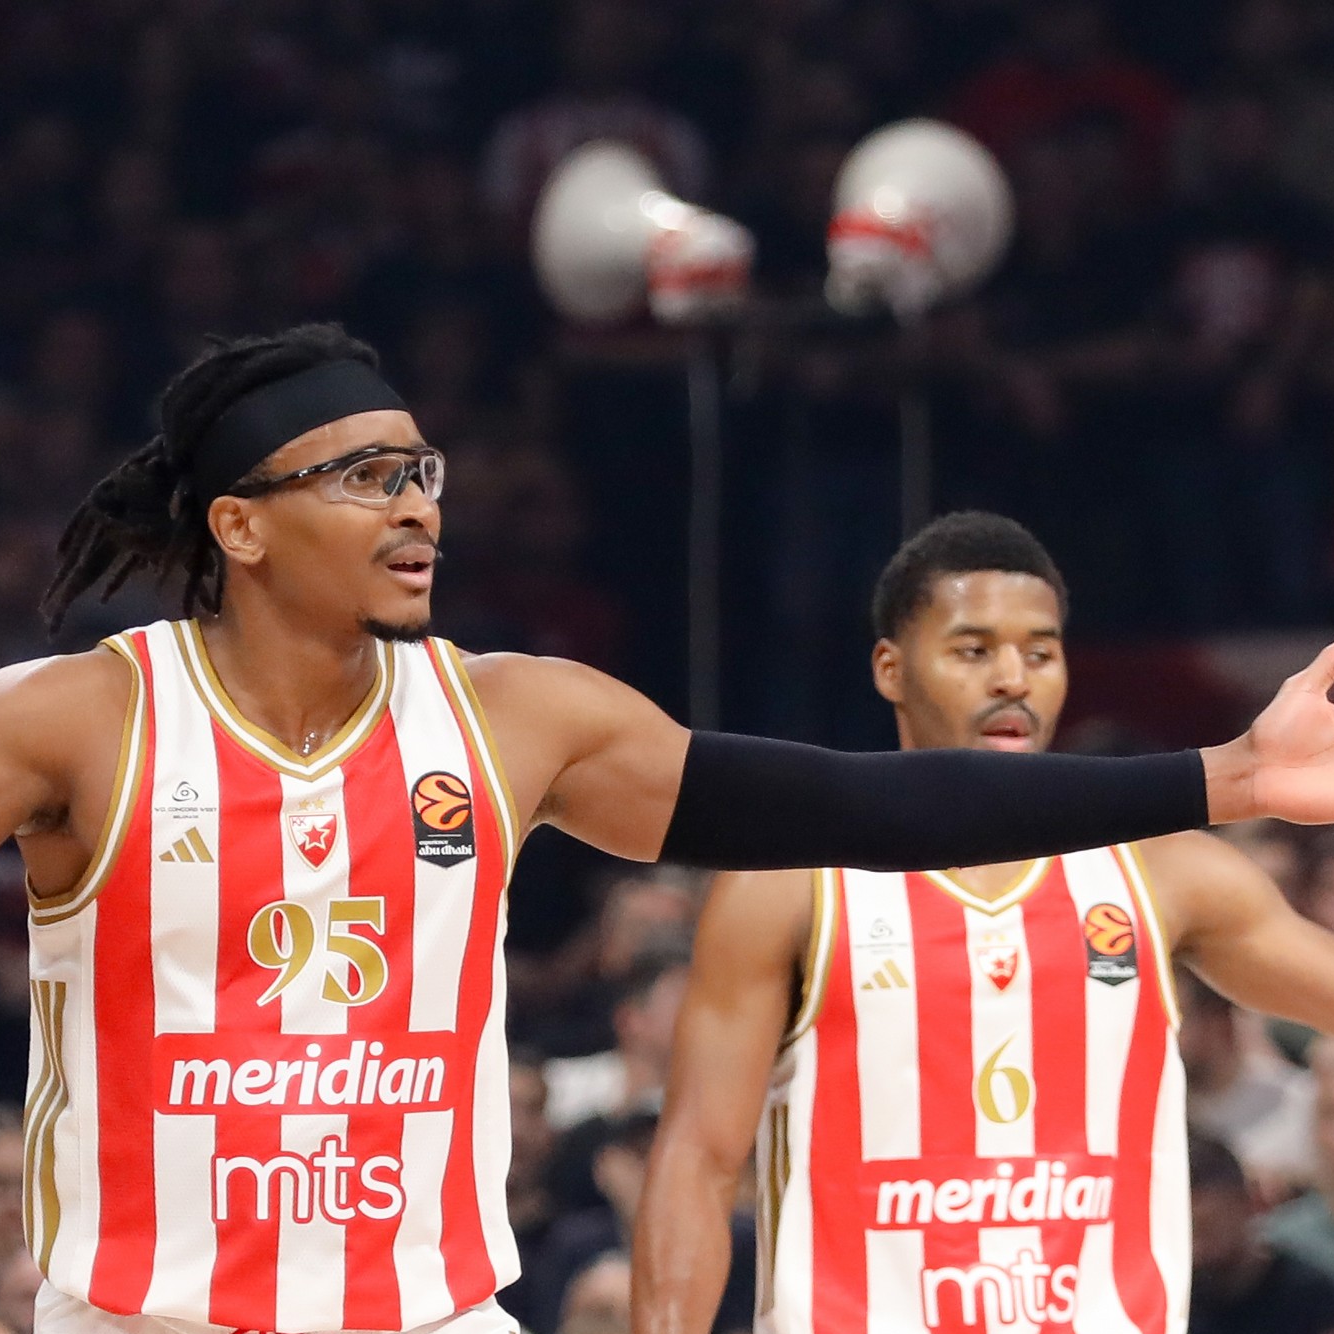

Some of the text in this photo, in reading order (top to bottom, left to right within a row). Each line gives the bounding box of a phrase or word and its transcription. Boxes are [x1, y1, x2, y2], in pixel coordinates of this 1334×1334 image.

[247, 896, 389, 1008] 95
[168, 1040, 446, 1106] meridian
[977, 1031, 1031, 1124] 6
[214, 1138, 404, 1221] mts
[875, 1160, 1114, 1225] meridian
[921, 1249, 1079, 1328] mts
